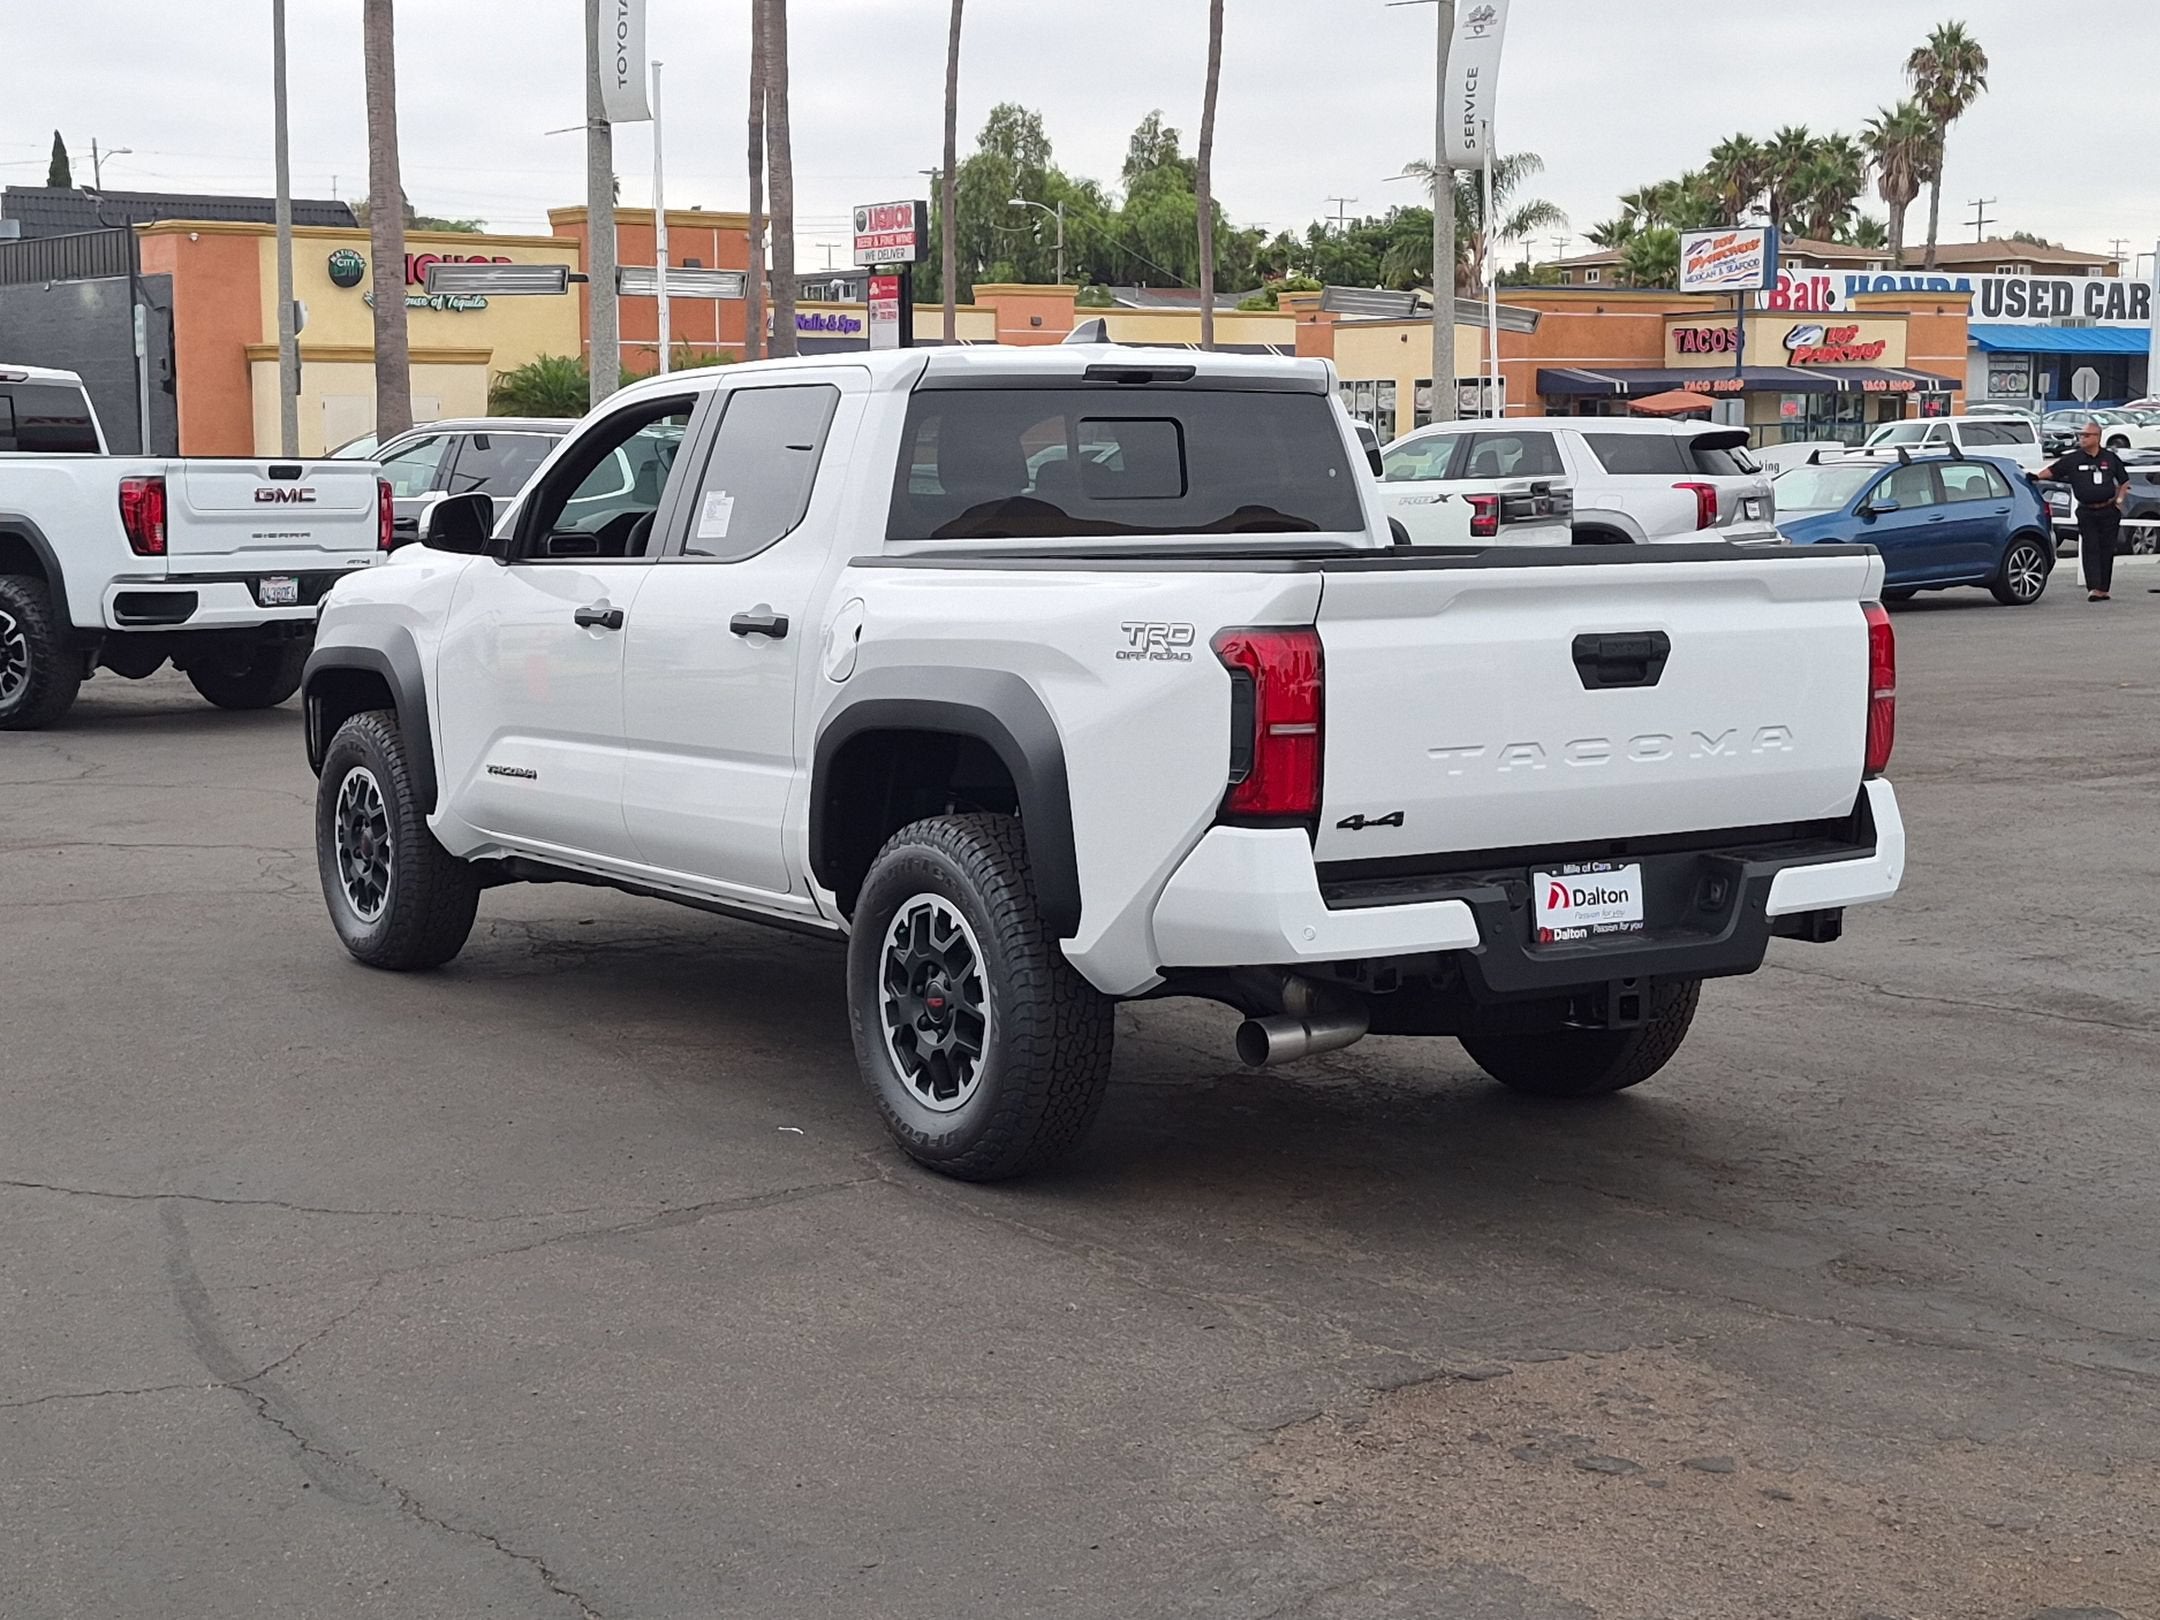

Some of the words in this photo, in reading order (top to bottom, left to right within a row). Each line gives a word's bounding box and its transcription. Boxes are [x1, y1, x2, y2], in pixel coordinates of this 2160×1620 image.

[1464, 67, 1478, 149] SERVICE
[868, 204, 913, 232] LIQUOR
[336, 258, 356, 267] CITY
[865, 250, 875, 261] WE
[877, 248, 906, 260] DELIVER
[1684, 269, 1717, 283] MEXICAN
[1726, 258, 1760, 273] SEAFOOD
[430, 295, 445, 310] of
[446, 295, 487, 311] Tequila
[1769, 276, 1829, 312] Ball
[1981, 278, 2073, 319] USED
[827, 314, 839, 331] &
[839, 314, 861, 334] Spa
[1672, 327, 1743, 353] TACOS
[1824, 324, 1859, 345] LOS
[1683, 379, 1711, 392] TACO
[1713, 379, 1744, 391] SHOP
[1862, 380, 1887, 391] TACO
[1889, 380, 1916, 391] SHOP
[254, 488, 317, 503] GMC
[1121, 621, 1195, 652] TRD
[1115, 650, 1147, 661] OFF
[1149, 651, 1193, 662] ROAD
[1427, 724, 1793, 775] TACOMA
[1563, 864, 1580, 874] Mile
[1581, 862, 1591, 872] of
[1592, 861, 1612, 872] Cars
[1572, 885, 1629, 907] Dalton
[1553, 927, 1588, 941] Dalton
[1592, 923, 1619, 934] Passion
[1619, 922, 1630, 931] for
[1630, 921, 1644, 932] you
